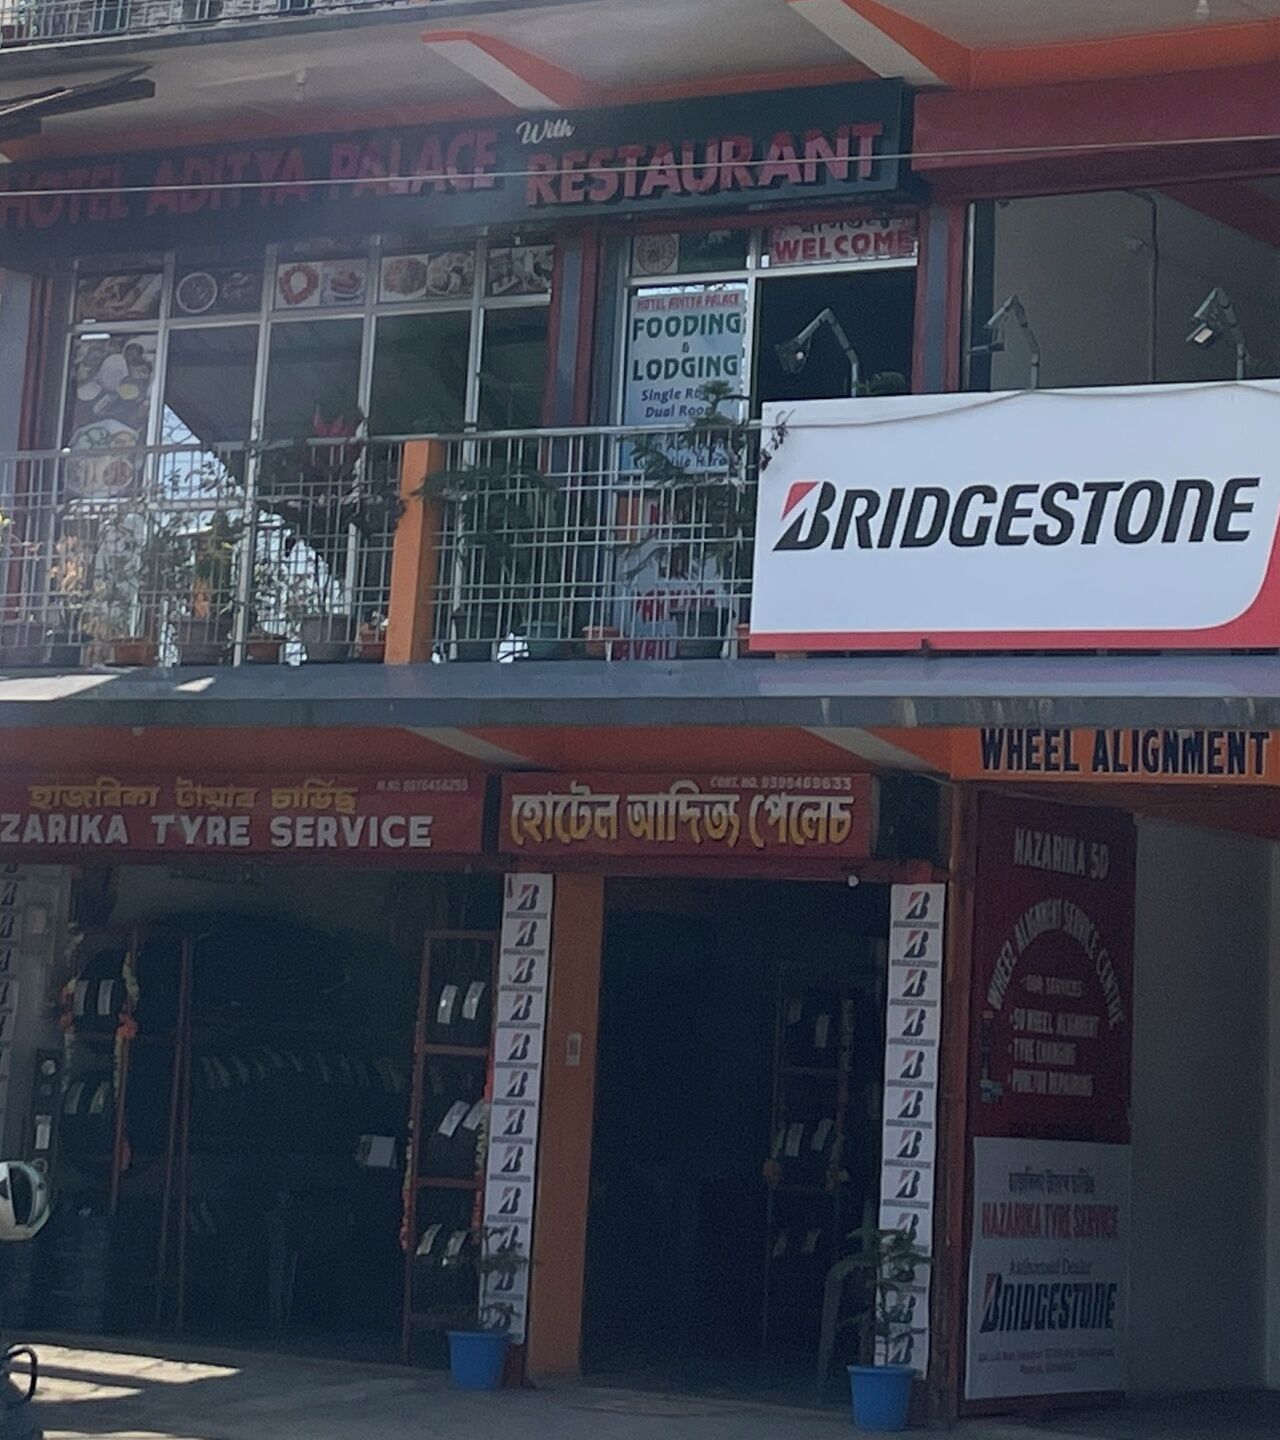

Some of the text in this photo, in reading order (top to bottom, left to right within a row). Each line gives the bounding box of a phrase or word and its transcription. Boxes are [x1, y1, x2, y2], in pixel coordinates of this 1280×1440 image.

[516, 118, 576, 146] With
[147, 146, 309, 218] ADITYA
[329, 127, 499, 200] PALACE
[525, 122, 884, 206] RESTAURANT
[775, 229, 914, 264] WELCOME
[632, 312, 742, 342] FOODING
[681, 341, 691, 355] &
[632, 354, 739, 382] LODGING
[641, 386, 682, 405] Single
[645, 404, 675, 419] Dual
[772, 477, 1261, 551] BRIDGESTONE
[980, 728, 1079, 774] WHEEL
[1091, 728, 1271, 777] ALIGNMENT
[152, 814, 250, 847] TYRE
[270, 815, 434, 848] SERVICE
[982, 1202, 1041, 1239] HAZARIKA
[980, 1273, 1118, 1334] BRIDGESTONE
